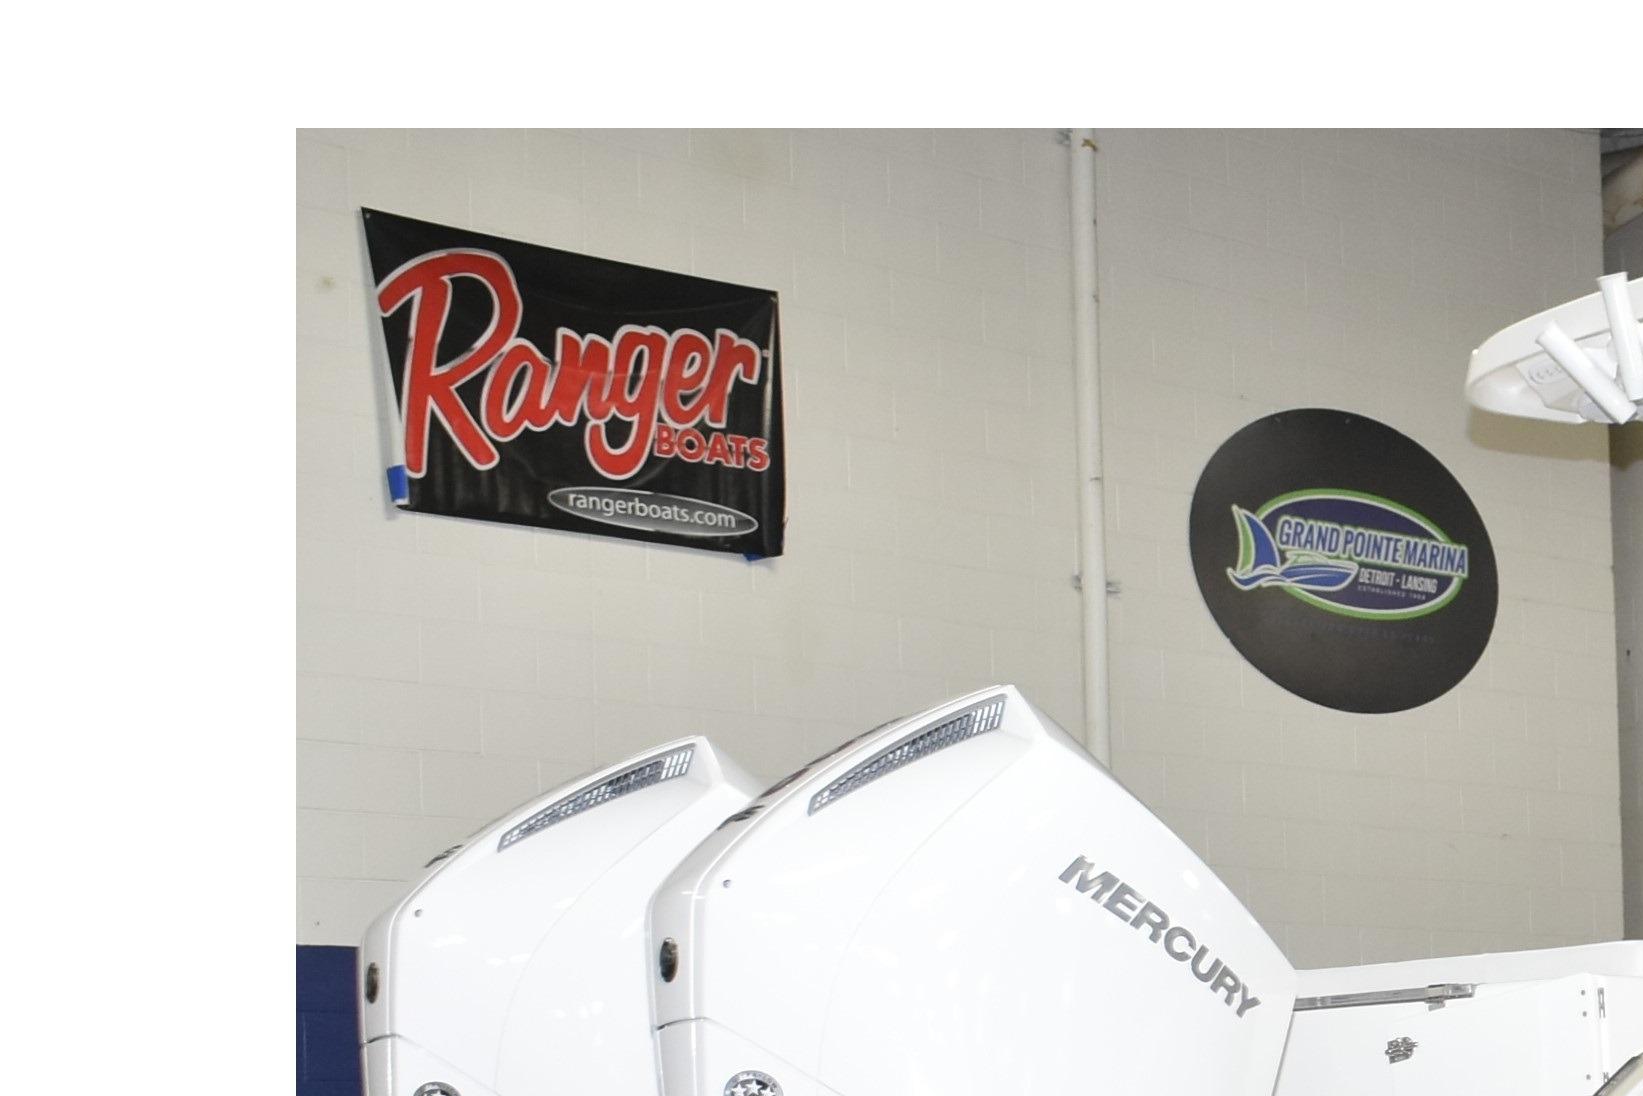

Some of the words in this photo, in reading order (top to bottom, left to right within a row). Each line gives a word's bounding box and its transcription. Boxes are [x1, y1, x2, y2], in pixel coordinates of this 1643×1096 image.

[377, 248, 760, 480] Ranger
[654, 424, 771, 473] BOATS
[567, 491, 737, 530] rangerboats.com
[1278, 518, 1341, 555] GRAND
[1343, 528, 1402, 564] POINTE
[1402, 537, 1469, 575] MARINA
[1358, 567, 1396, 587] DETROIT
[1400, 573, 1438, 594] LANSING
[1057, 854, 1262, 1018] MERCURY
